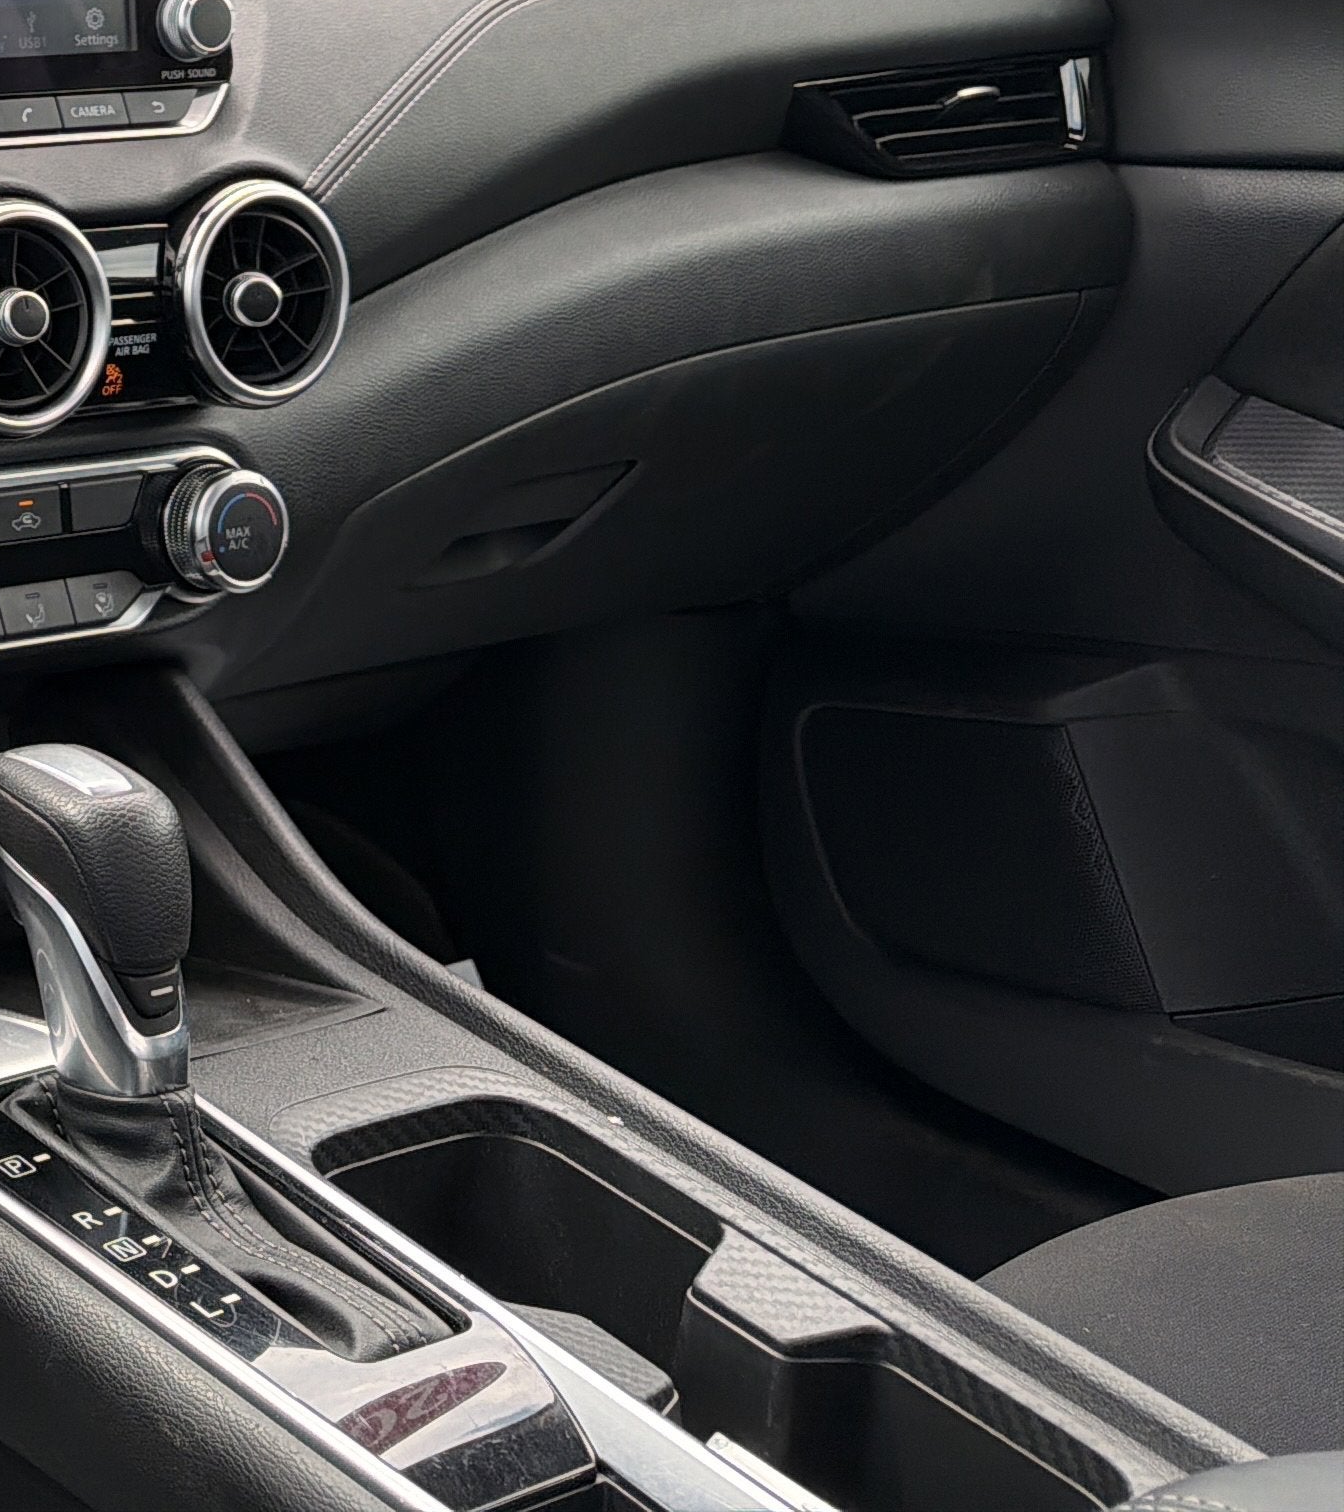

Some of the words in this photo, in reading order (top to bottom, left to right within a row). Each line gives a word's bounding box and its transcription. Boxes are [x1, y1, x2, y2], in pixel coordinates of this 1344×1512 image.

[74, 34, 119, 48] Settings
[161, 69, 185, 80] PUSH
[187, 67, 217, 79] SOUND
[69, 103, 117, 119] CAMERA
[108, 332, 158, 346] PASSENGER
[114, 346, 131, 357] AIR
[131, 344, 151, 356] BAG
[101, 384, 124, 397] OFF
[225, 526, 251, 541] MAX
[228, 537, 250, 551] A/C
[4, 1159, 23, 1175] P
[71, 1210, 104, 1230] R
[112, 1241, 136, 1258] N
[148, 1269, 180, 1289] D
[189, 1300, 225, 1319] L
